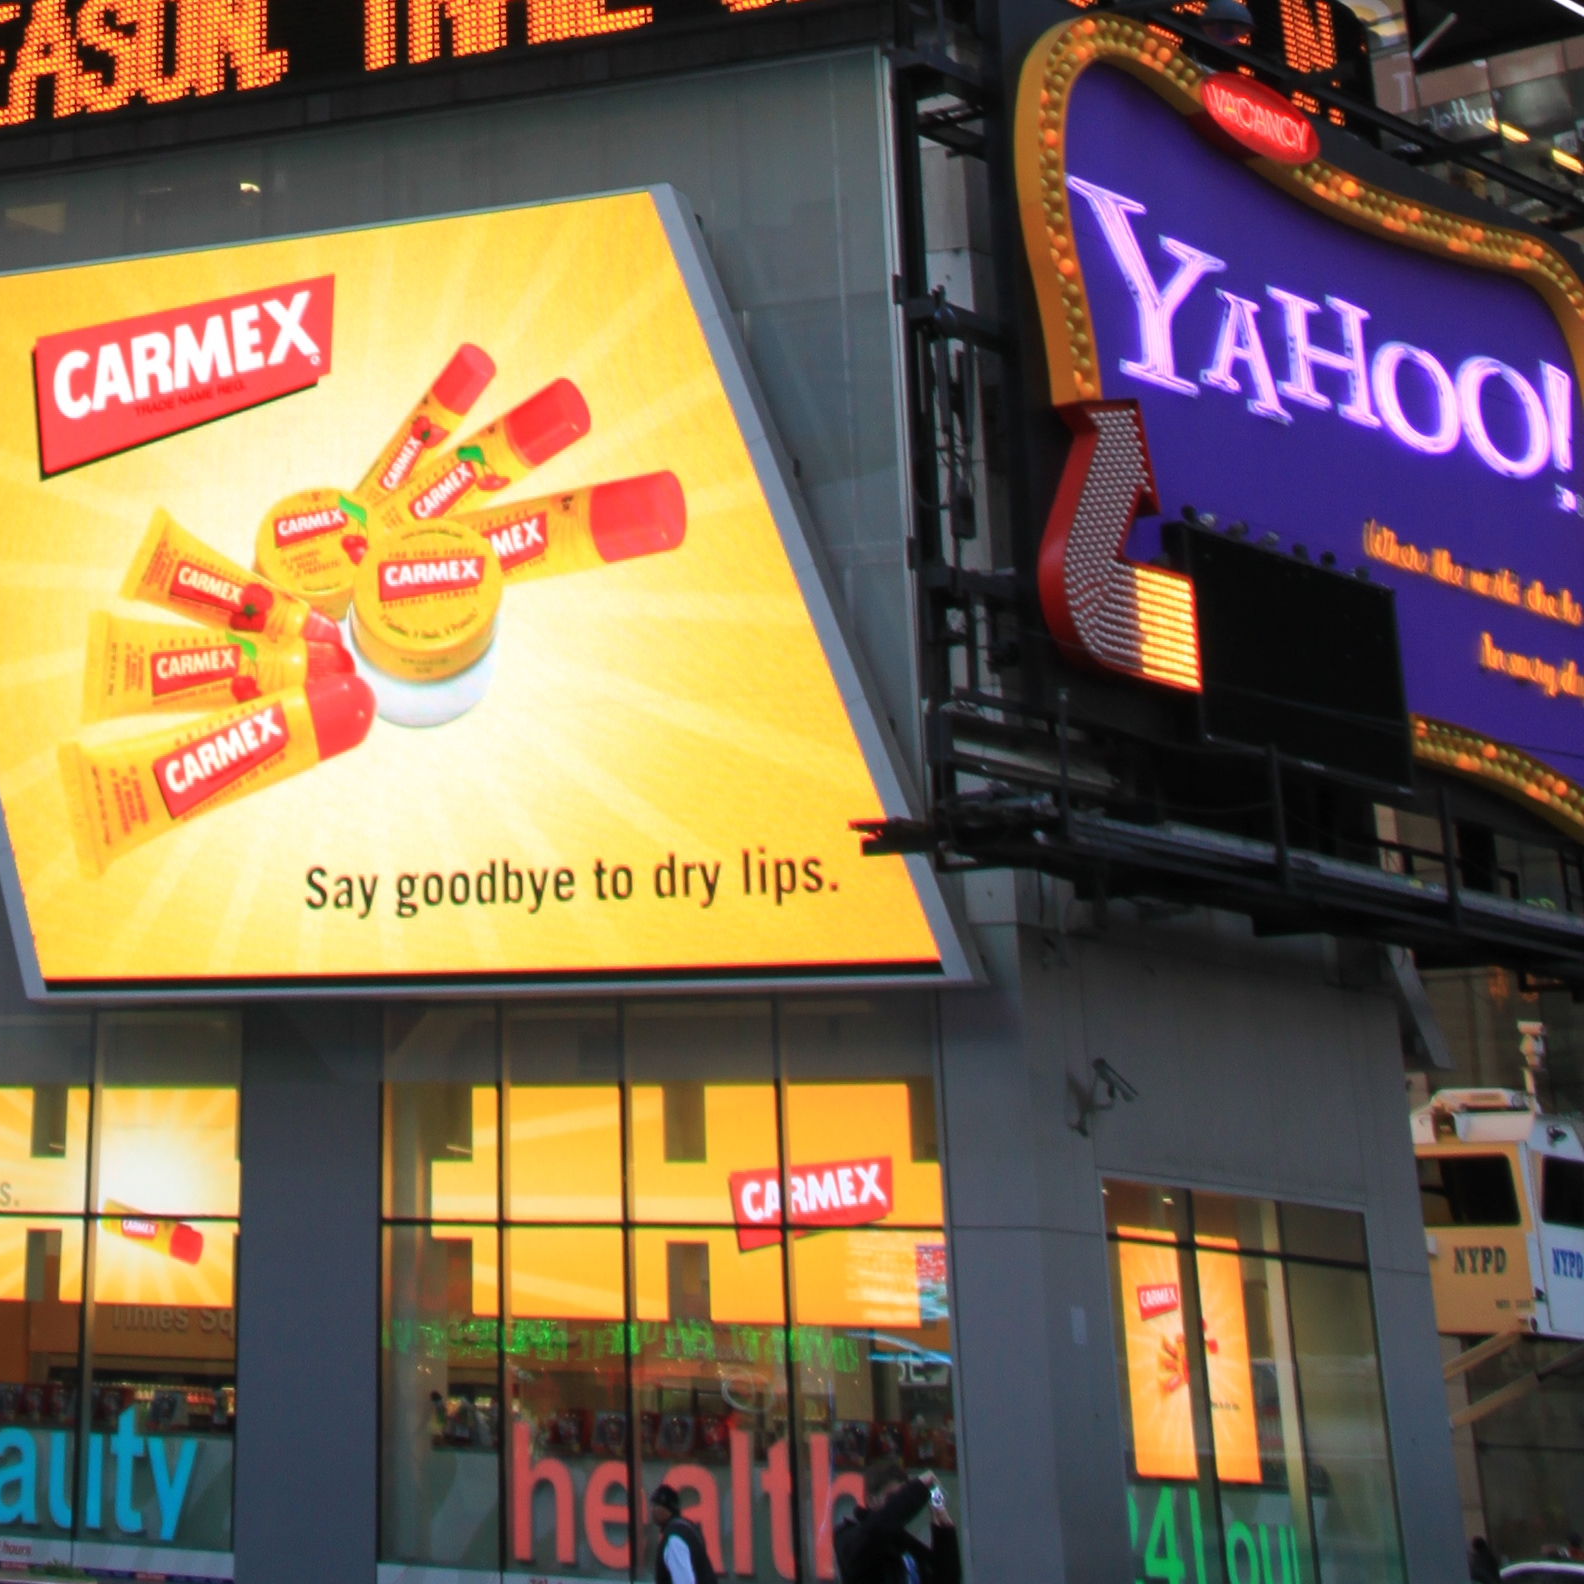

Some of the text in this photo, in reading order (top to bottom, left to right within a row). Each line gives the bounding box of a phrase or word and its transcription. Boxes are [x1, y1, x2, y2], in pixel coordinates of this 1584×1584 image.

[1205, 83, 1309, 154] VACANCY
[53, 289, 321, 420] CARMEX
[1063, 173, 1577, 513] YAHOO!
[382, 436, 423, 490] CARMEX
[414, 462, 475, 519] CARMEX
[277, 509, 346, 538] CARMEX
[177, 565, 243, 606] CARMEX
[384, 557, 480, 588] CARMEX
[156, 647, 236, 680] CARMEX
[165, 707, 283, 794] CARMEX
[304, 847, 842, 919] Say goodbye to dry lips.
[740, 1162, 888, 1222] CARMEX
[122, 1219, 156, 1236] CARMEX
[1454, 1246, 1507, 1274] NYPD
[1552, 1247, 1584, 1280] NYPD
[1139, 1286, 1178, 1310] CARMEX
